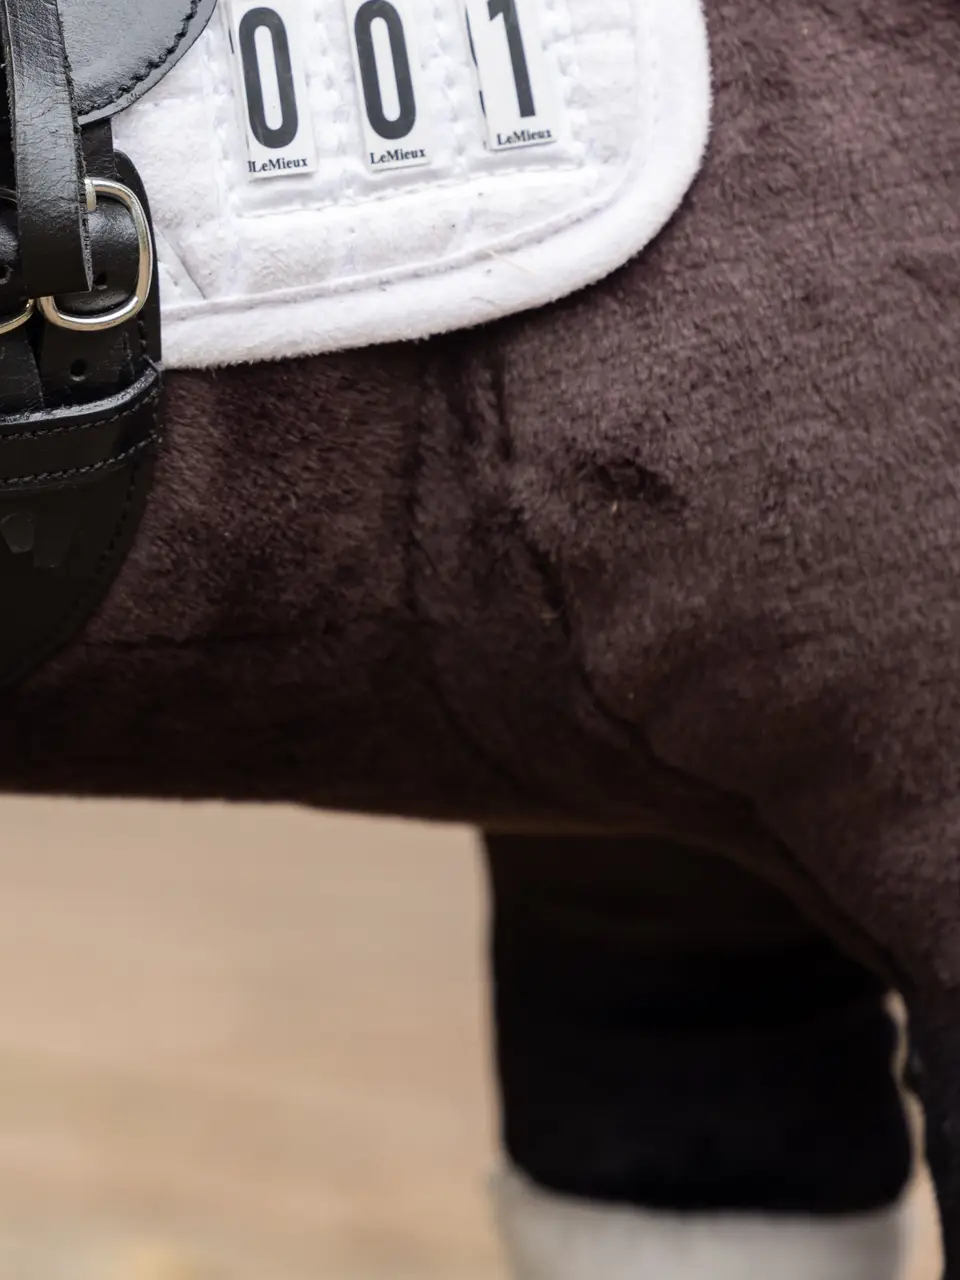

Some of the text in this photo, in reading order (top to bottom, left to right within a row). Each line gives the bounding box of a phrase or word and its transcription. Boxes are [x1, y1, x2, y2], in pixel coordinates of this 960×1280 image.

[239, 7, 299, 149] 0
[496, 128, 552, 146] LeMieux
[370, 147, 426, 165] LeMieux
